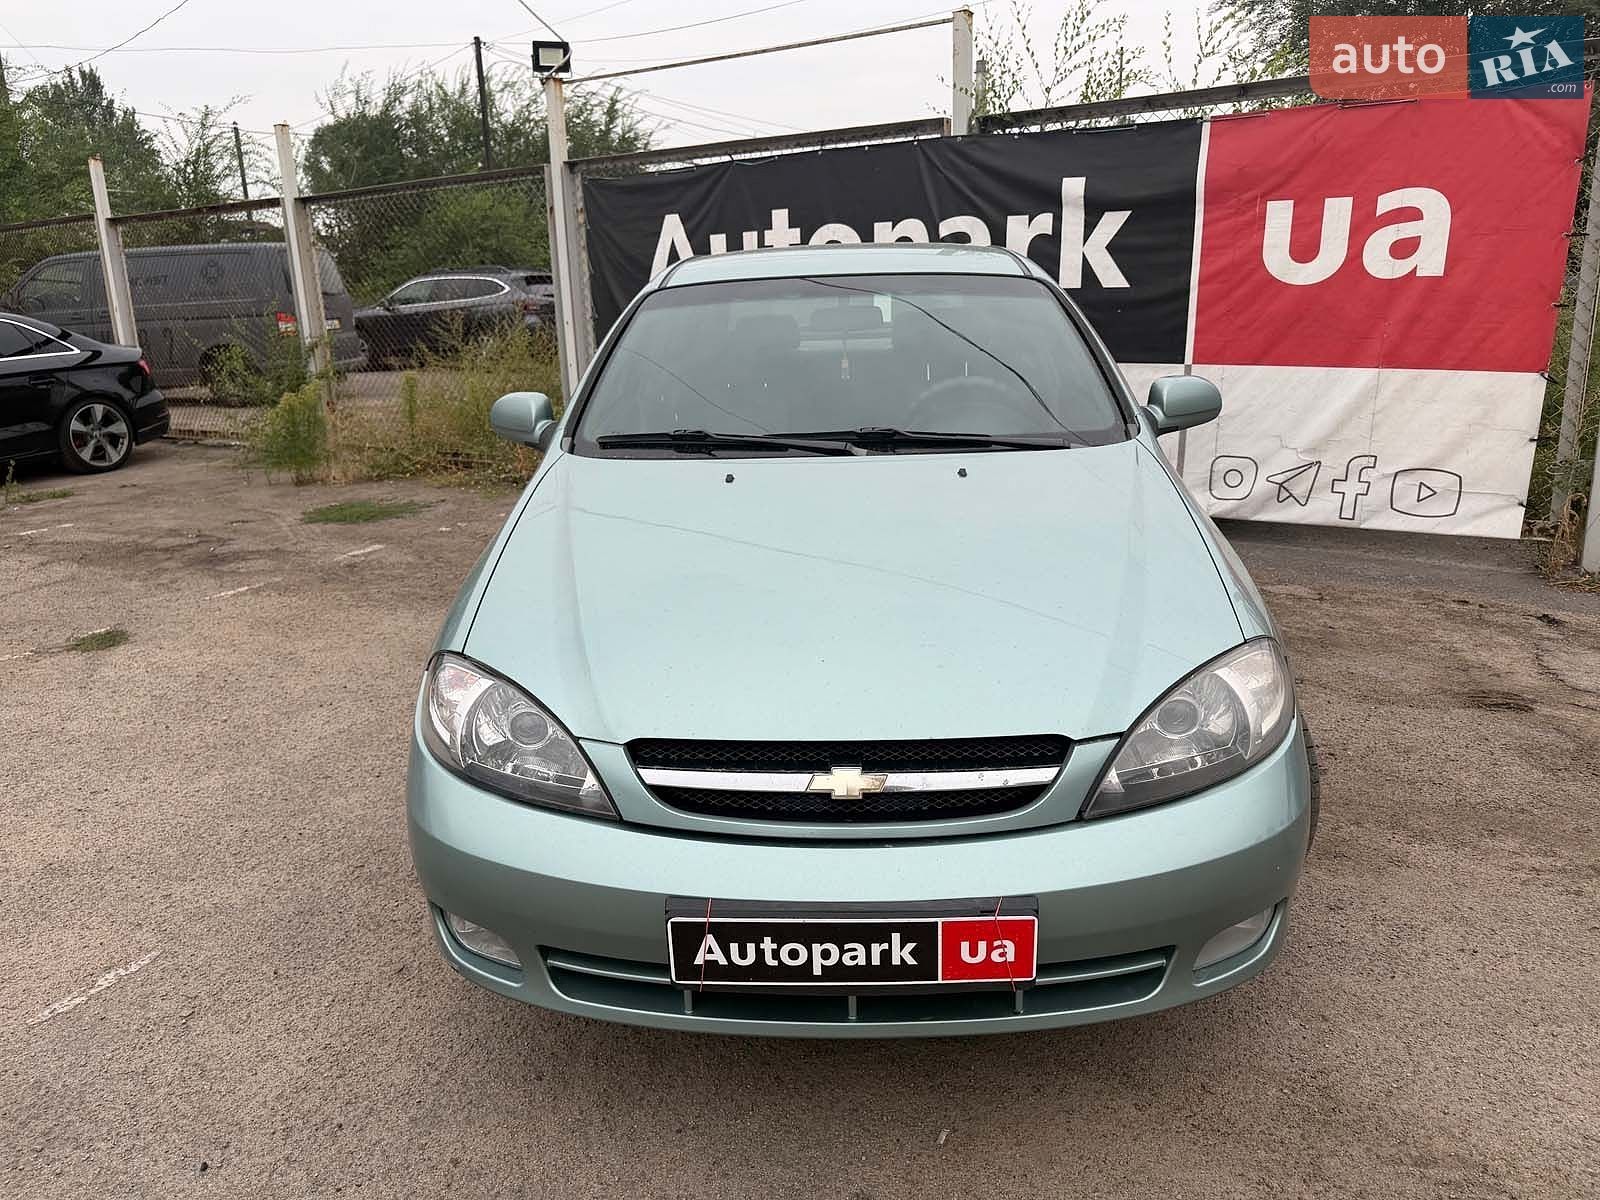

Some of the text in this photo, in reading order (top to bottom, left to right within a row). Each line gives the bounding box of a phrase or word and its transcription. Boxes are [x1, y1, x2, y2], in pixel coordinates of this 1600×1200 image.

[648, 176, 1452, 289] Atrk ua
[693, 932, 1016, 975] Autopark ua
